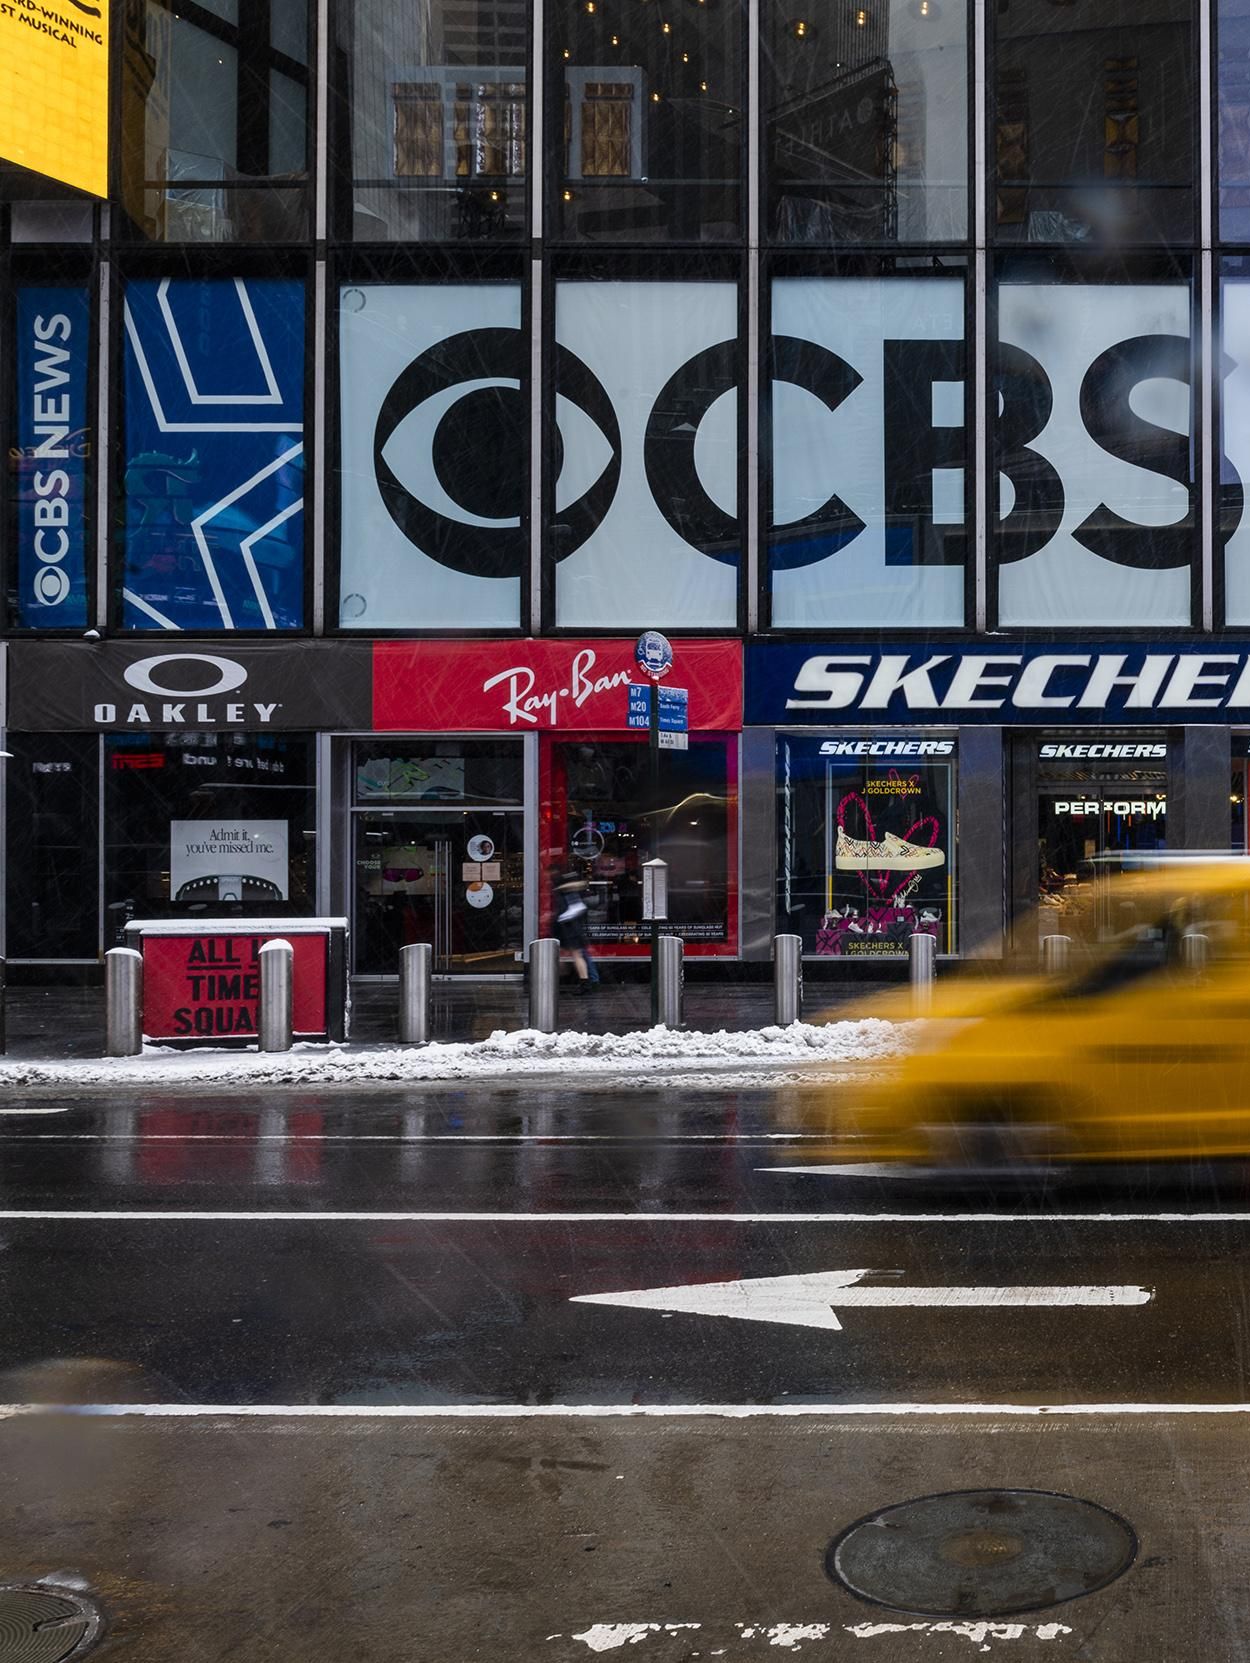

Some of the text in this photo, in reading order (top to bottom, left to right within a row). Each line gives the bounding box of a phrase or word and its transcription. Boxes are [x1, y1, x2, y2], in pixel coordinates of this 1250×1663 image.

[18, 12, 77, 49] MUSICAL
[33, 313, 72, 564] CBS NEWS
[643, 333, 1245, 571] CBS
[483, 648, 632, 725] Ray-Ban
[630, 687, 642, 697] M7
[94, 703, 279, 723] OAKLEY
[630, 701, 647, 712] M20
[629, 716, 650, 727] M104
[819, 741, 955, 755] SKECHERS
[1039, 744, 1167, 758] SKECHERS
[861, 787, 922, 795] J GOLDCROWN
[865, 780, 915, 788] SKECHERS X
[209, 828, 251, 842] Admit it,
[186, 842, 275, 856] you've missed me.
[188, 938, 241, 963] ALL
[186, 974, 259, 1001] TIME
[174, 1007, 259, 1035] SQUA
